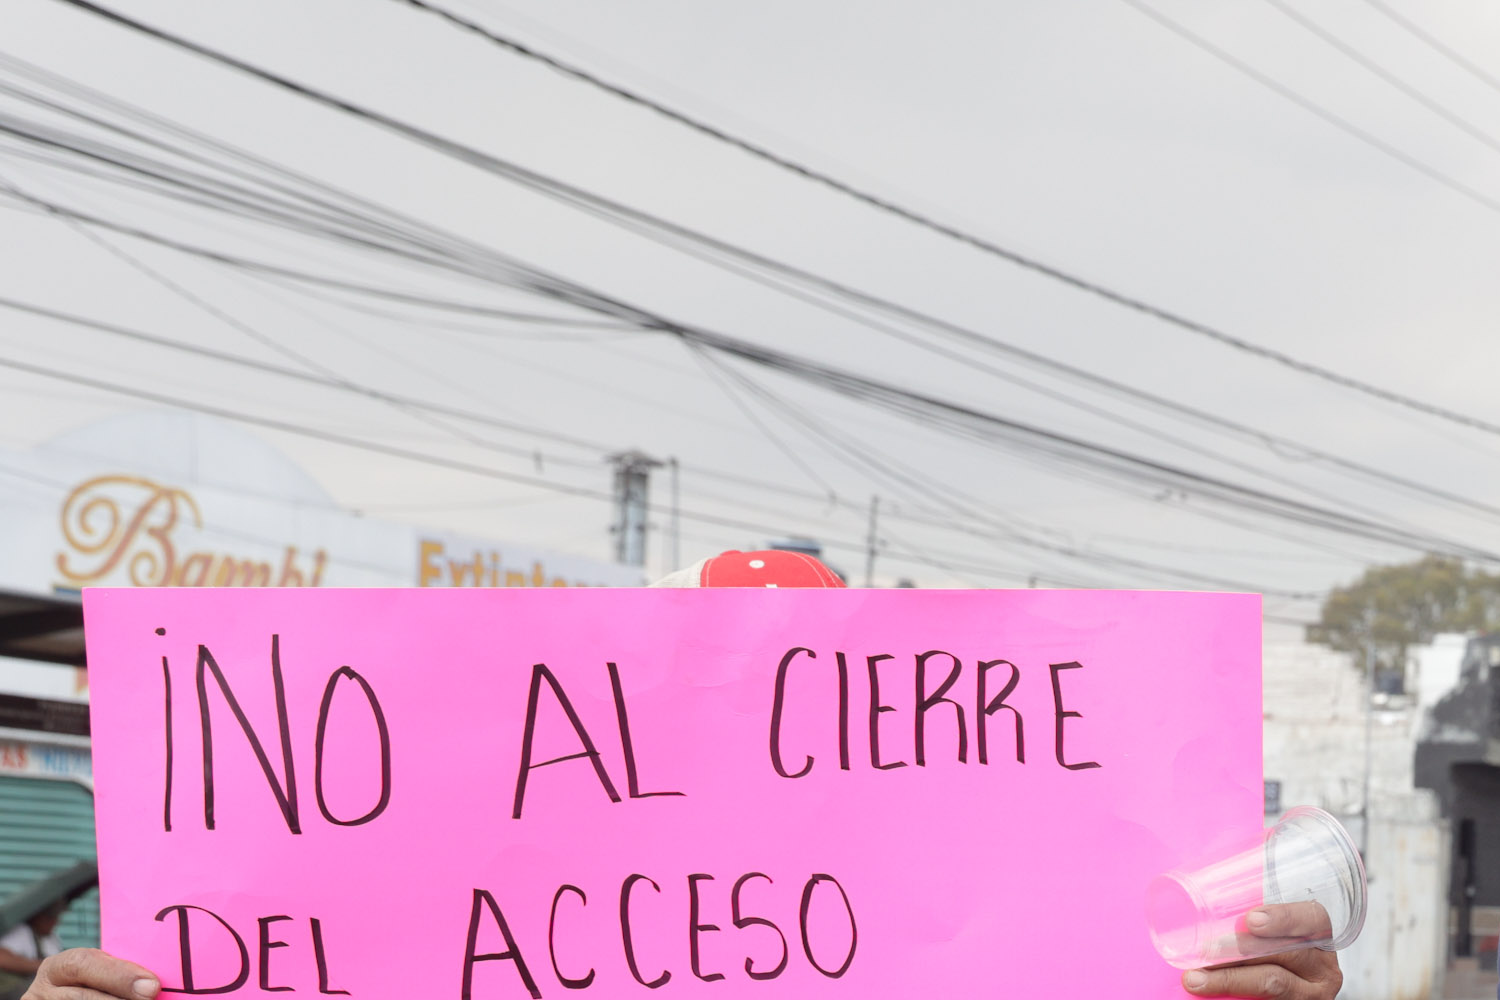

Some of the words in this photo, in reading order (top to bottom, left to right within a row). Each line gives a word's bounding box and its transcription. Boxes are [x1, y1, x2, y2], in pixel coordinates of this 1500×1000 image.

[511, 659, 686, 820] AL
[769, 646, 1102, 779] CIERRE
[154, 904, 352, 996] DEL
